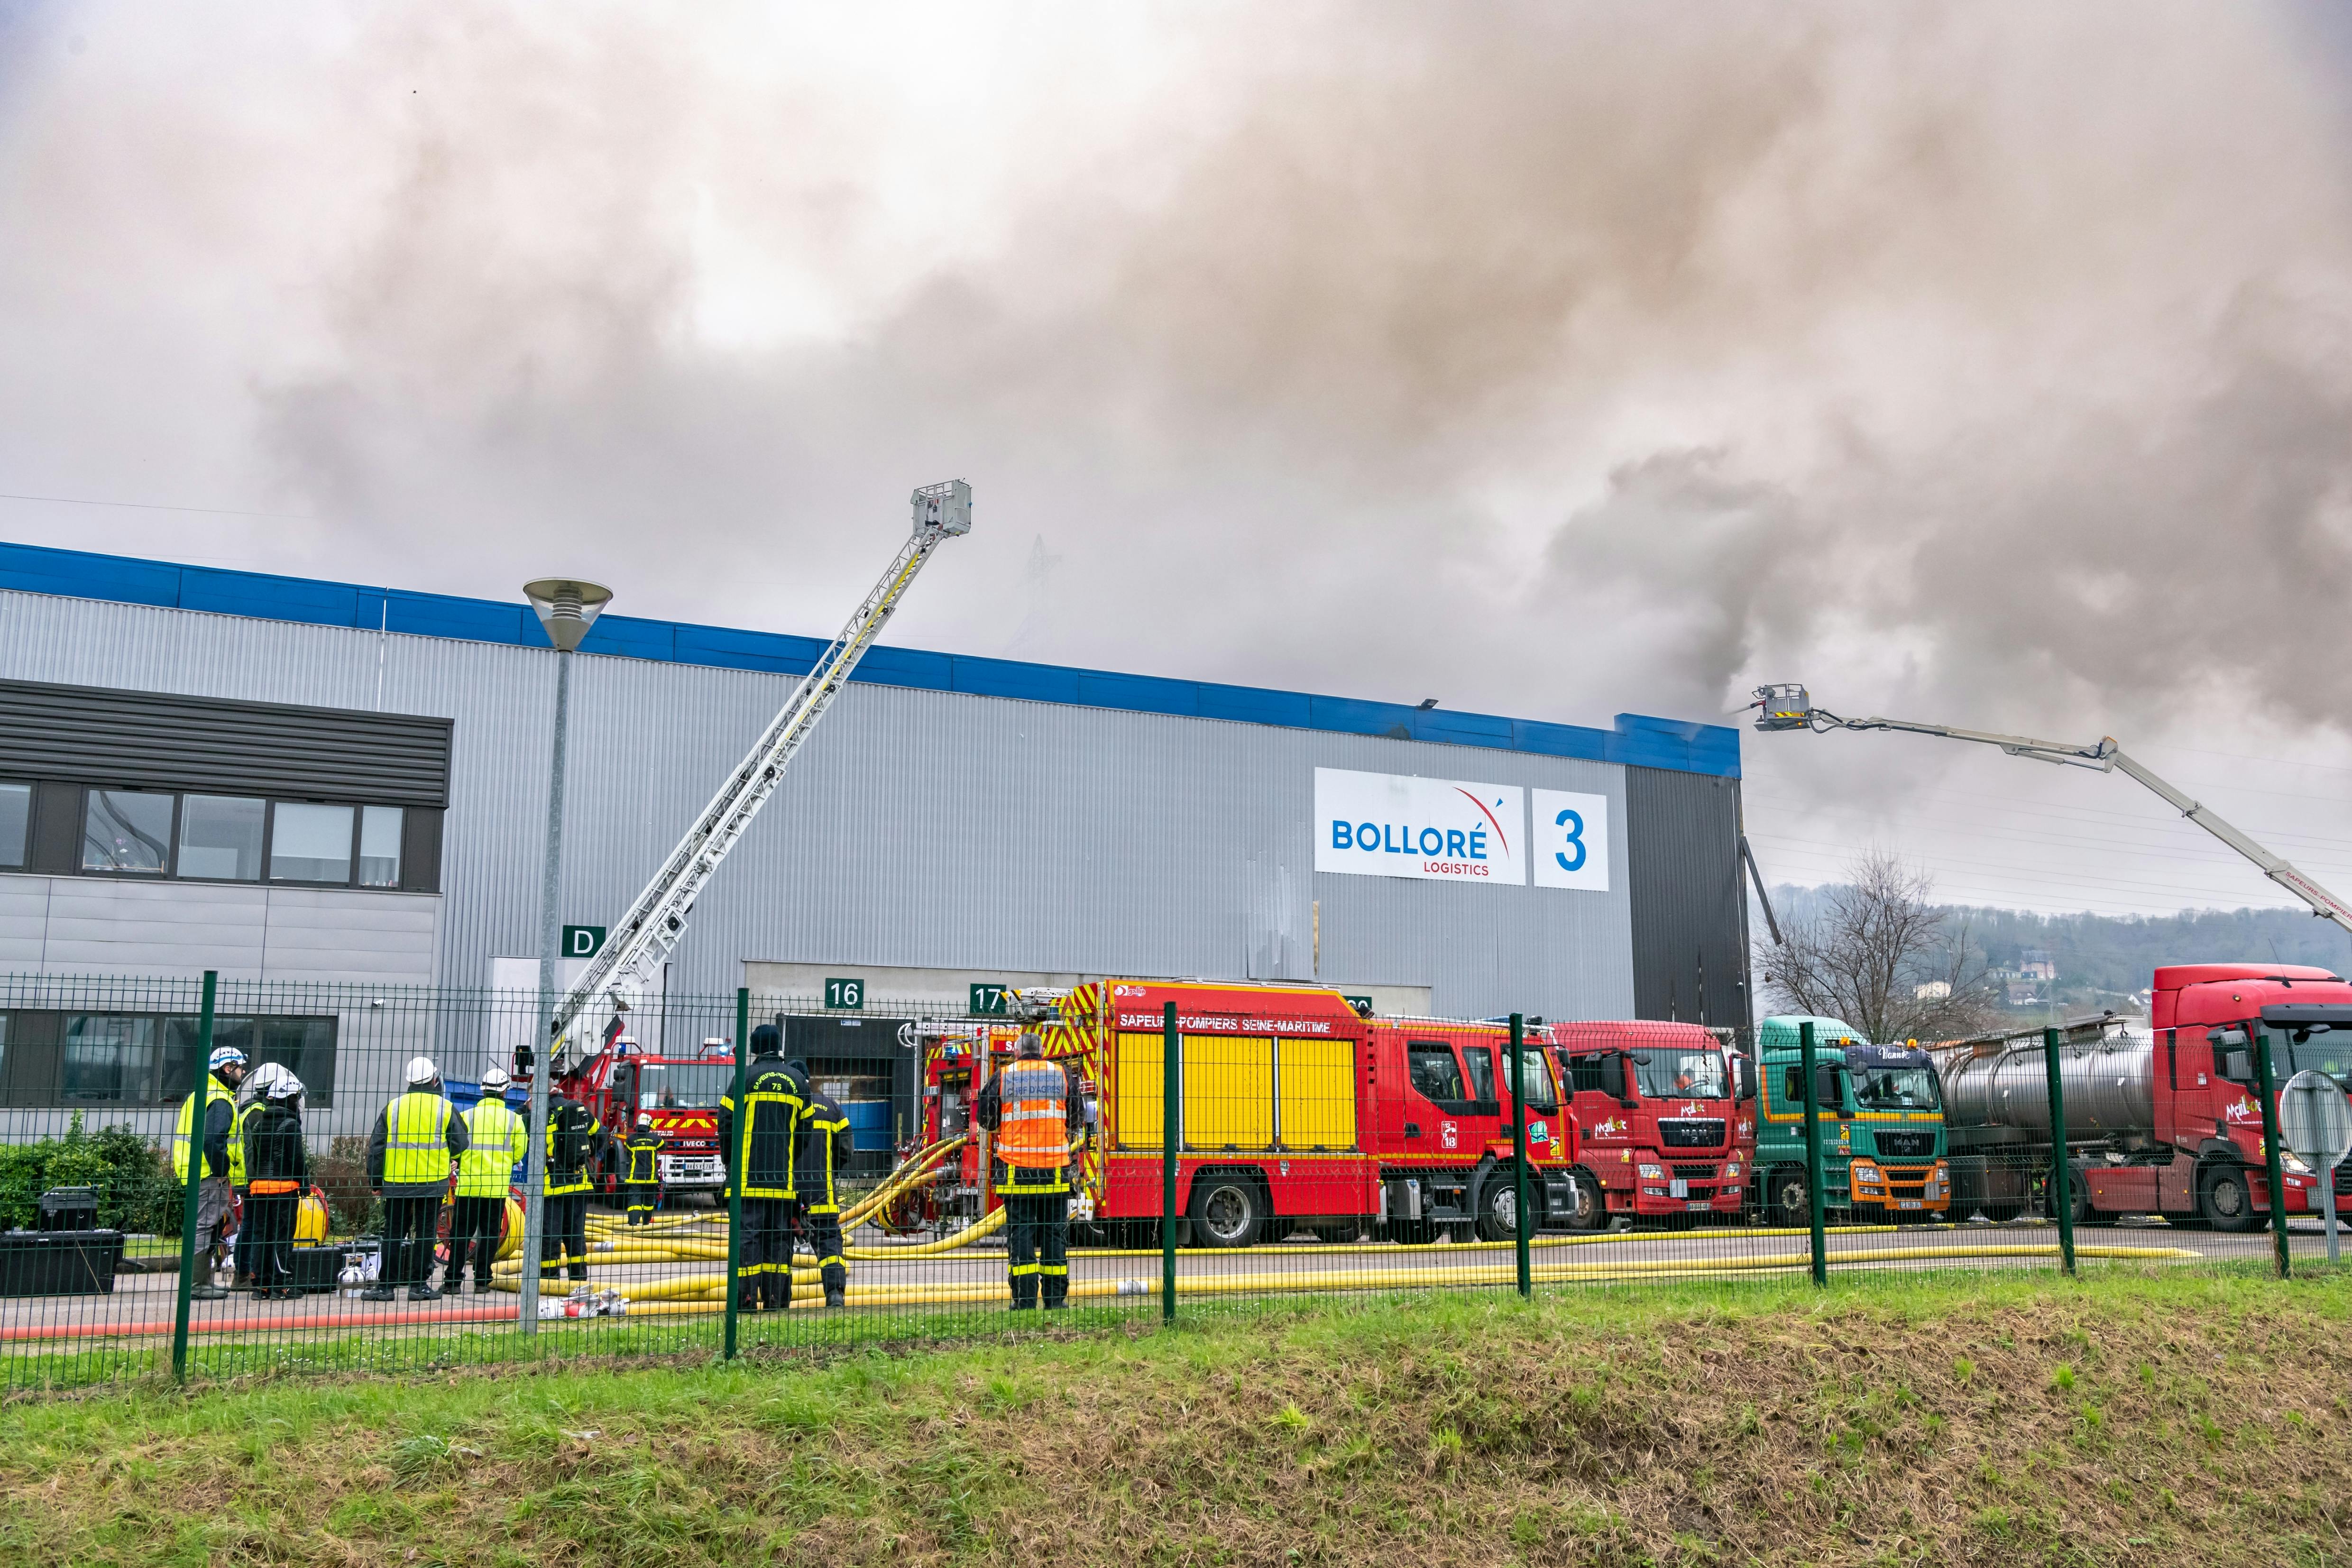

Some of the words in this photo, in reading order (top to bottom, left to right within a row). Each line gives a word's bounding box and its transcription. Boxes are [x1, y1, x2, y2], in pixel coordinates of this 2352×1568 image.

[1332, 820, 1487, 860] BOLLORÉ
[1555, 809, 1586, 871] 3
[1424, 862, 1489, 876] LOGISTICS
[2285, 871, 2352, 921] SAPEURS-POMPIER
[574, 930, 594, 954] D
[831, 983, 858, 1005] 16
[976, 988, 1001, 1009] 17
[1128, 986, 1146, 996] gallin
[1120, 1014, 1238, 1030] SAPEUR-POMPIERS
[1242, 1019, 1331, 1033] SEINE-MARITIME
[1445, 1137, 1455, 1146] 18
